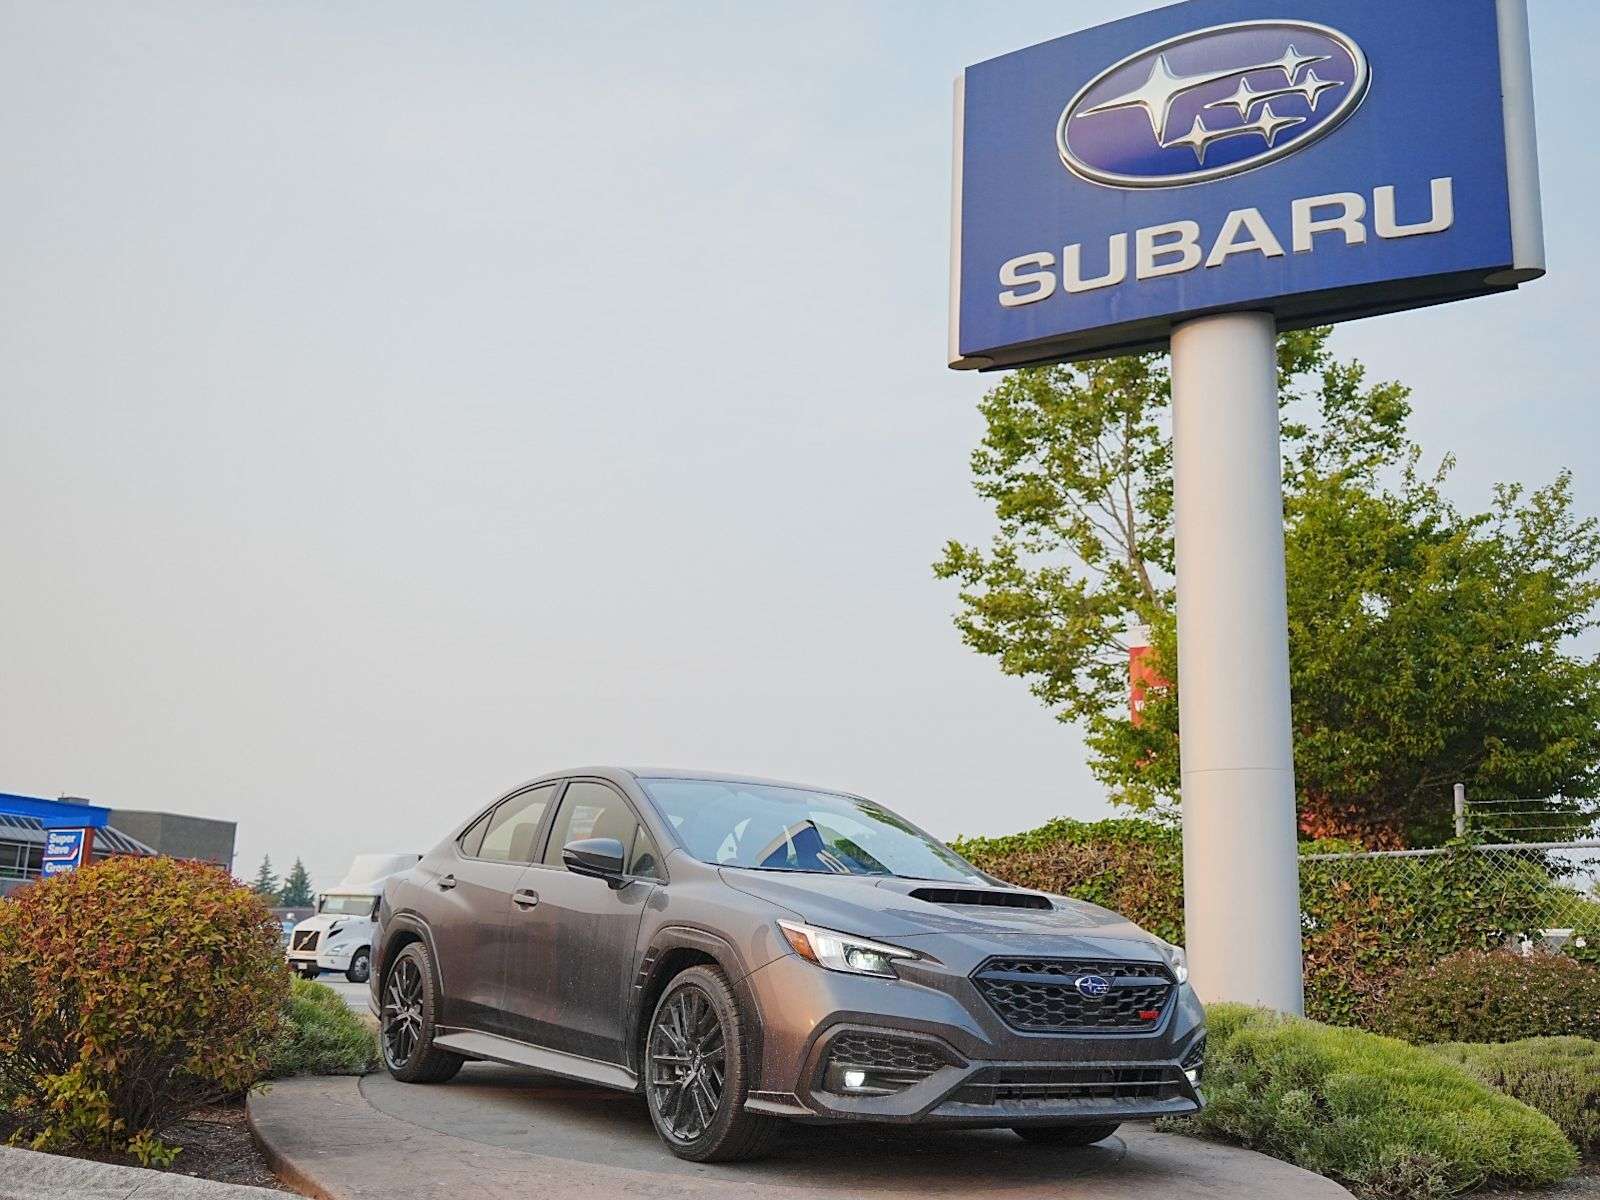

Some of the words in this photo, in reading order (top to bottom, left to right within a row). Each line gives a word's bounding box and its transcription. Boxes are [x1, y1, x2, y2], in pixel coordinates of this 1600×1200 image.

[999, 177, 1453, 307] SUBARU
[49, 833, 76, 845] Super
[48, 844, 70, 855] Save
